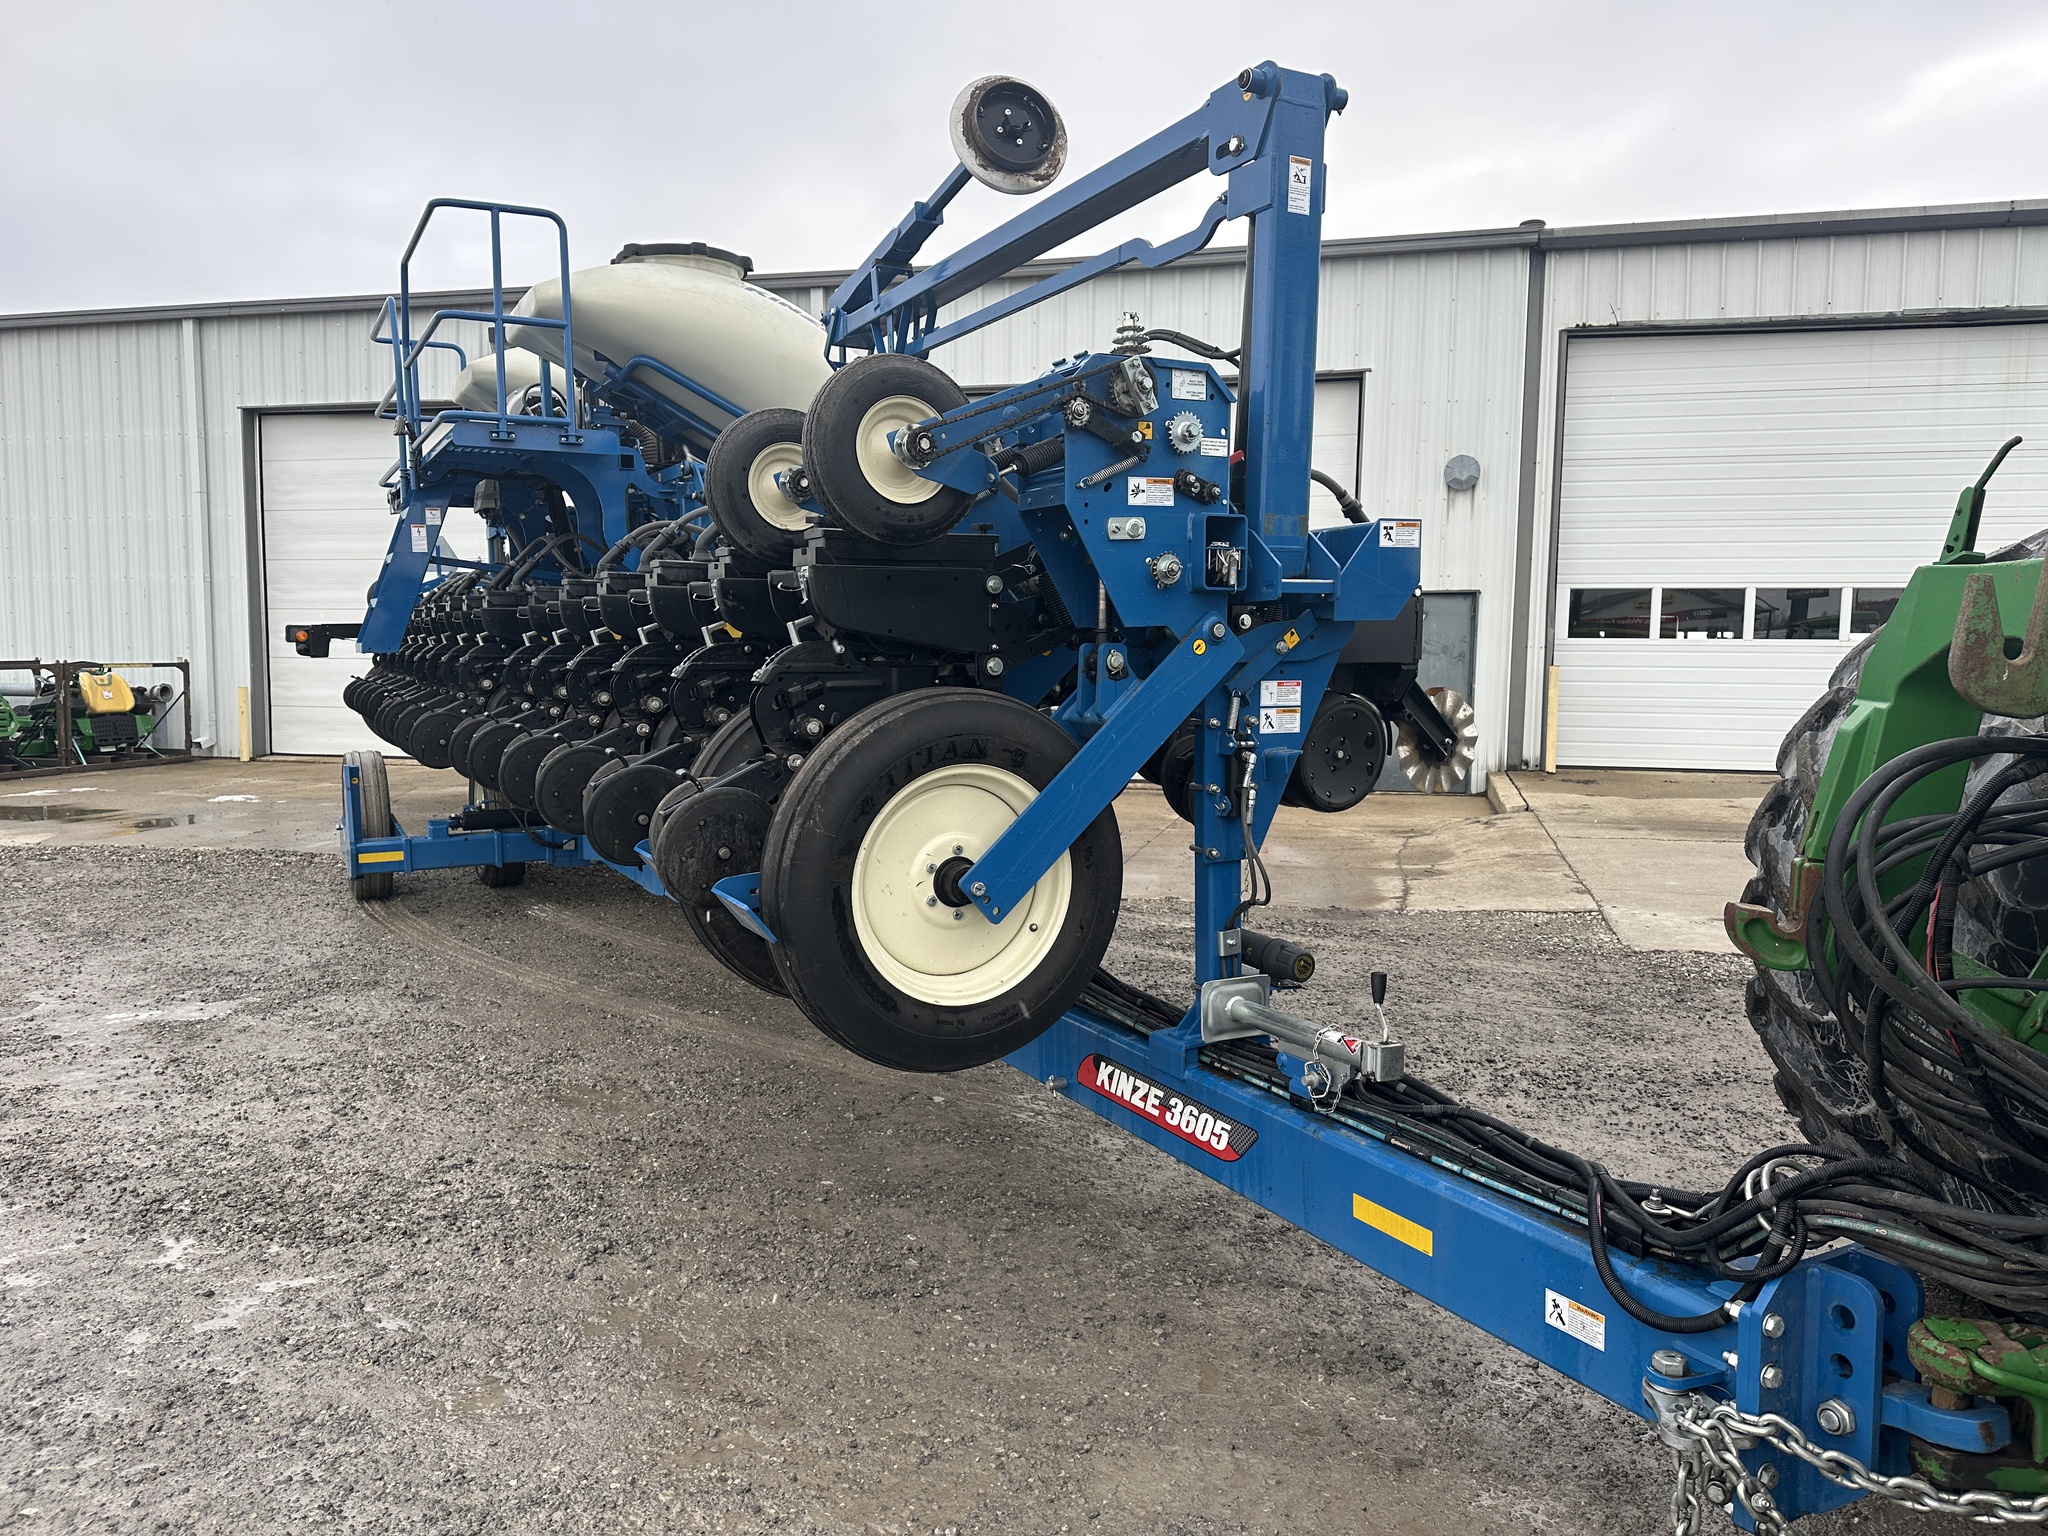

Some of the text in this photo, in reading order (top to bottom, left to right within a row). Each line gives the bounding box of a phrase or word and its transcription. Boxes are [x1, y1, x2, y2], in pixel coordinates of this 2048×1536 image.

[880, 737, 990, 794] TITAN
[1096, 1061, 1231, 1151] KINZE 3605
[1577, 1306, 1600, 1320] WARNING
